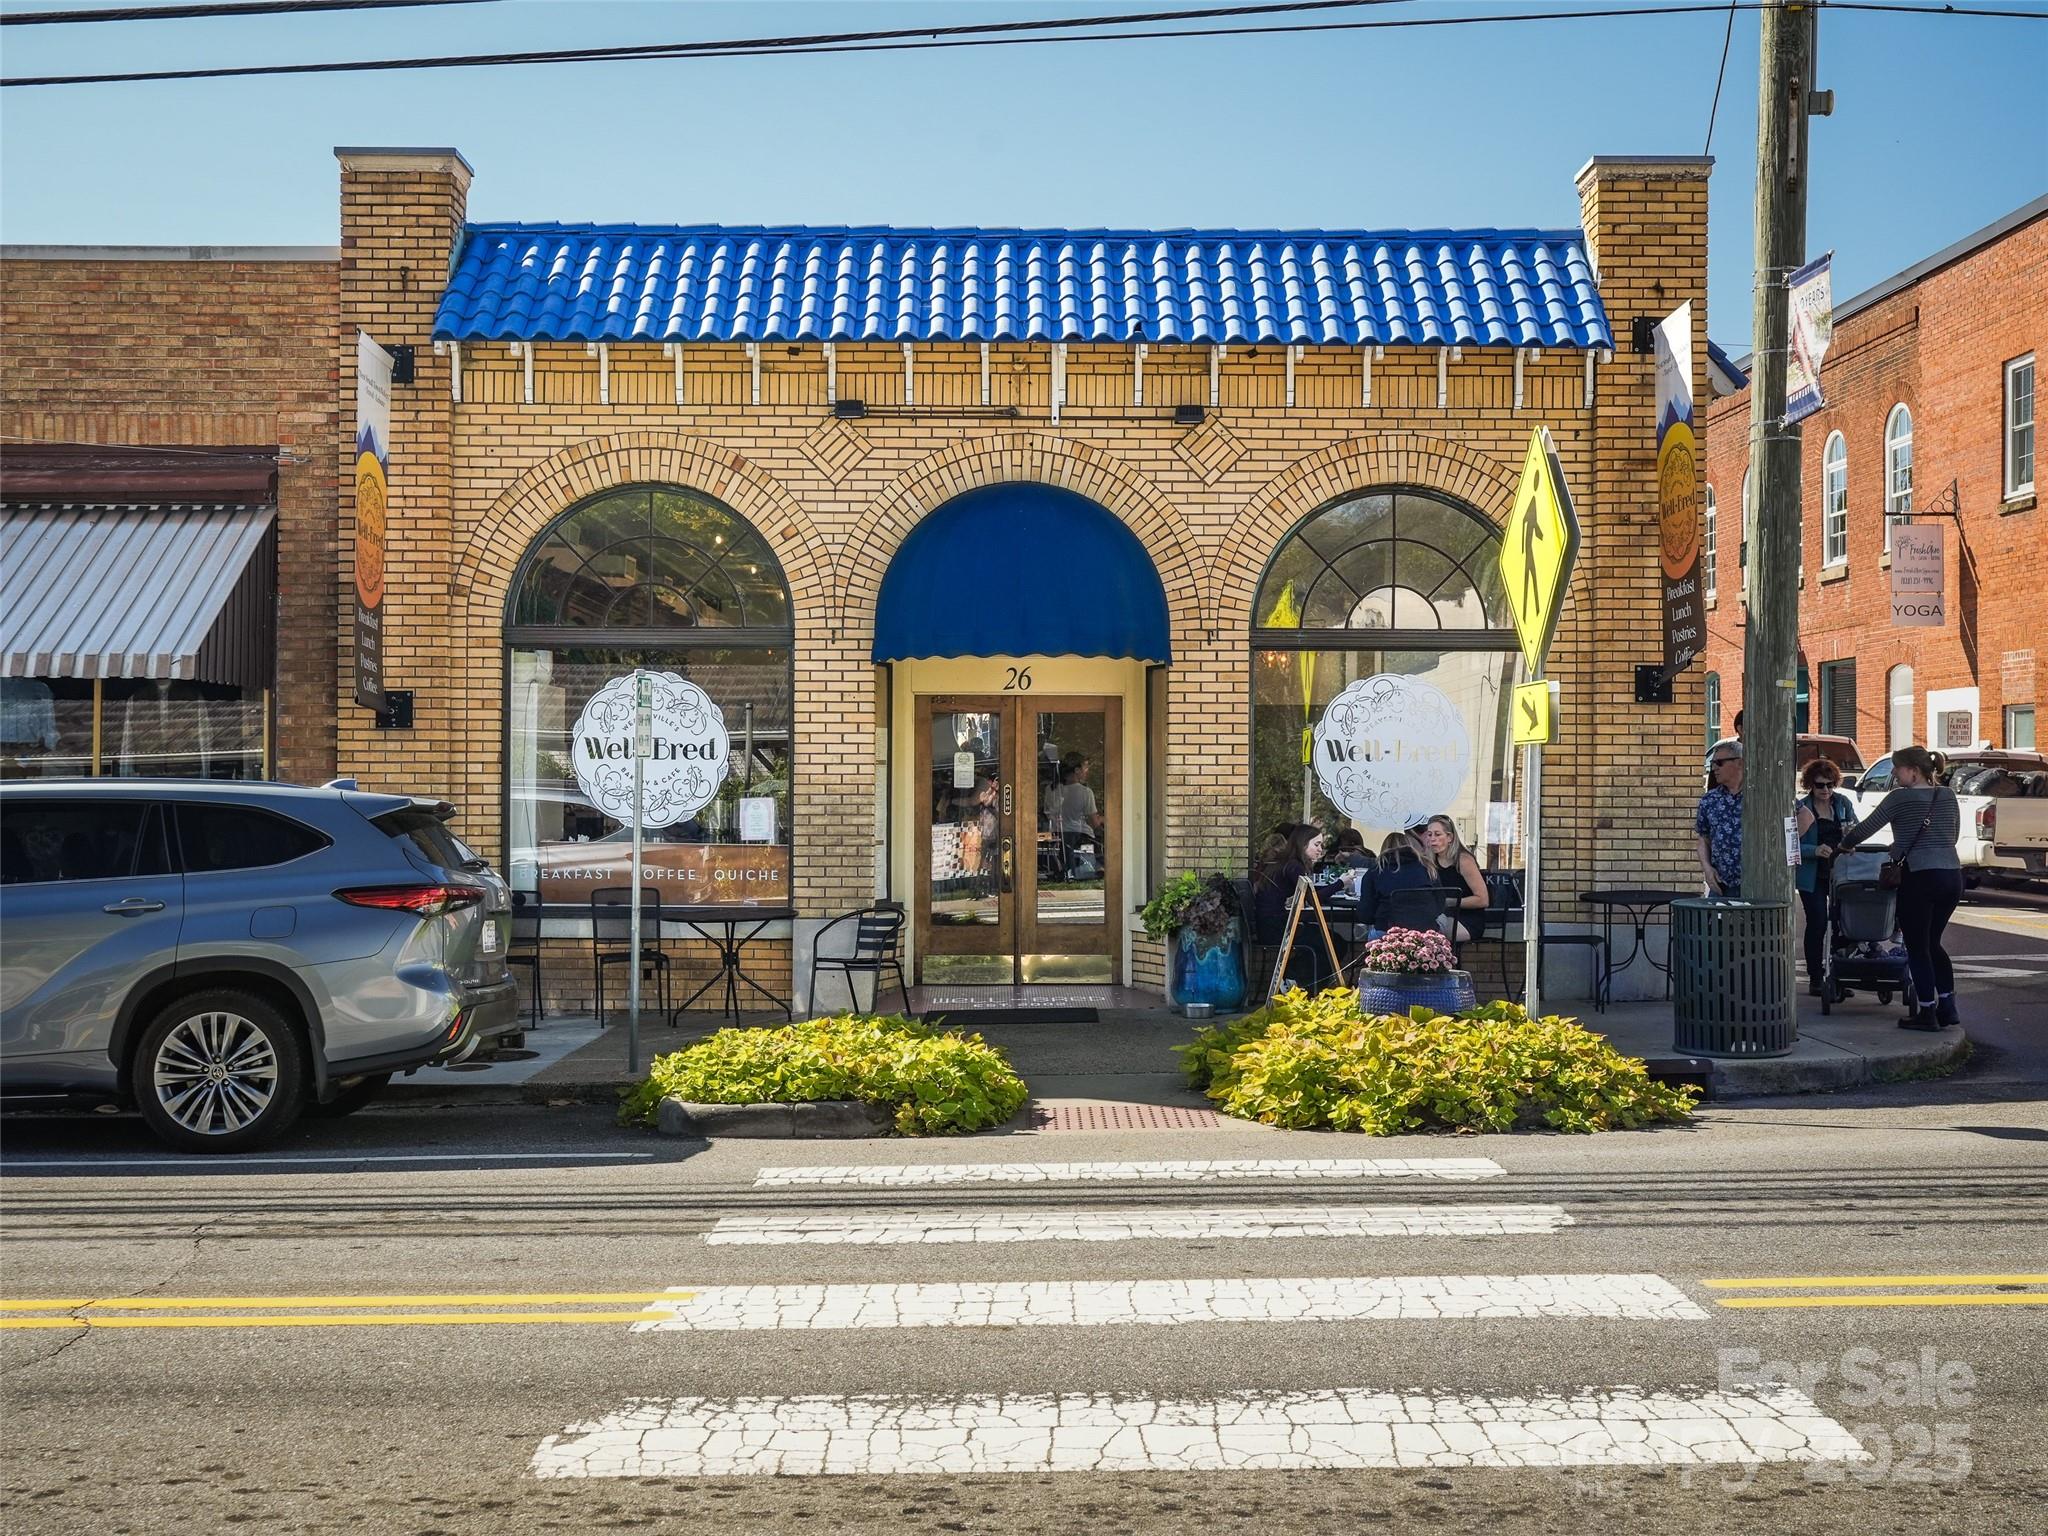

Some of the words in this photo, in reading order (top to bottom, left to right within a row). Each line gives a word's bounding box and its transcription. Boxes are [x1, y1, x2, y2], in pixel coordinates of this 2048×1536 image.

[1666, 579, 1695, 602] Breakfast
[358, 607, 379, 630] Breakfast
[1671, 601, 1692, 621] Lunch
[1892, 604, 1943, 617] YOGA
[361, 631, 376, 650] Lunch
[1671, 625, 1697, 644] Pastries
[360, 652, 378, 673] Pastries
[362, 675, 378, 695] Coffee
[1003, 666, 1032, 690] 26
[661, 767, 681, 784] CAFE
[519, 868, 614, 880] BREAKFAST
[631, 869, 696, 880] OFFEE
[714, 869, 779, 881] QUICHE
